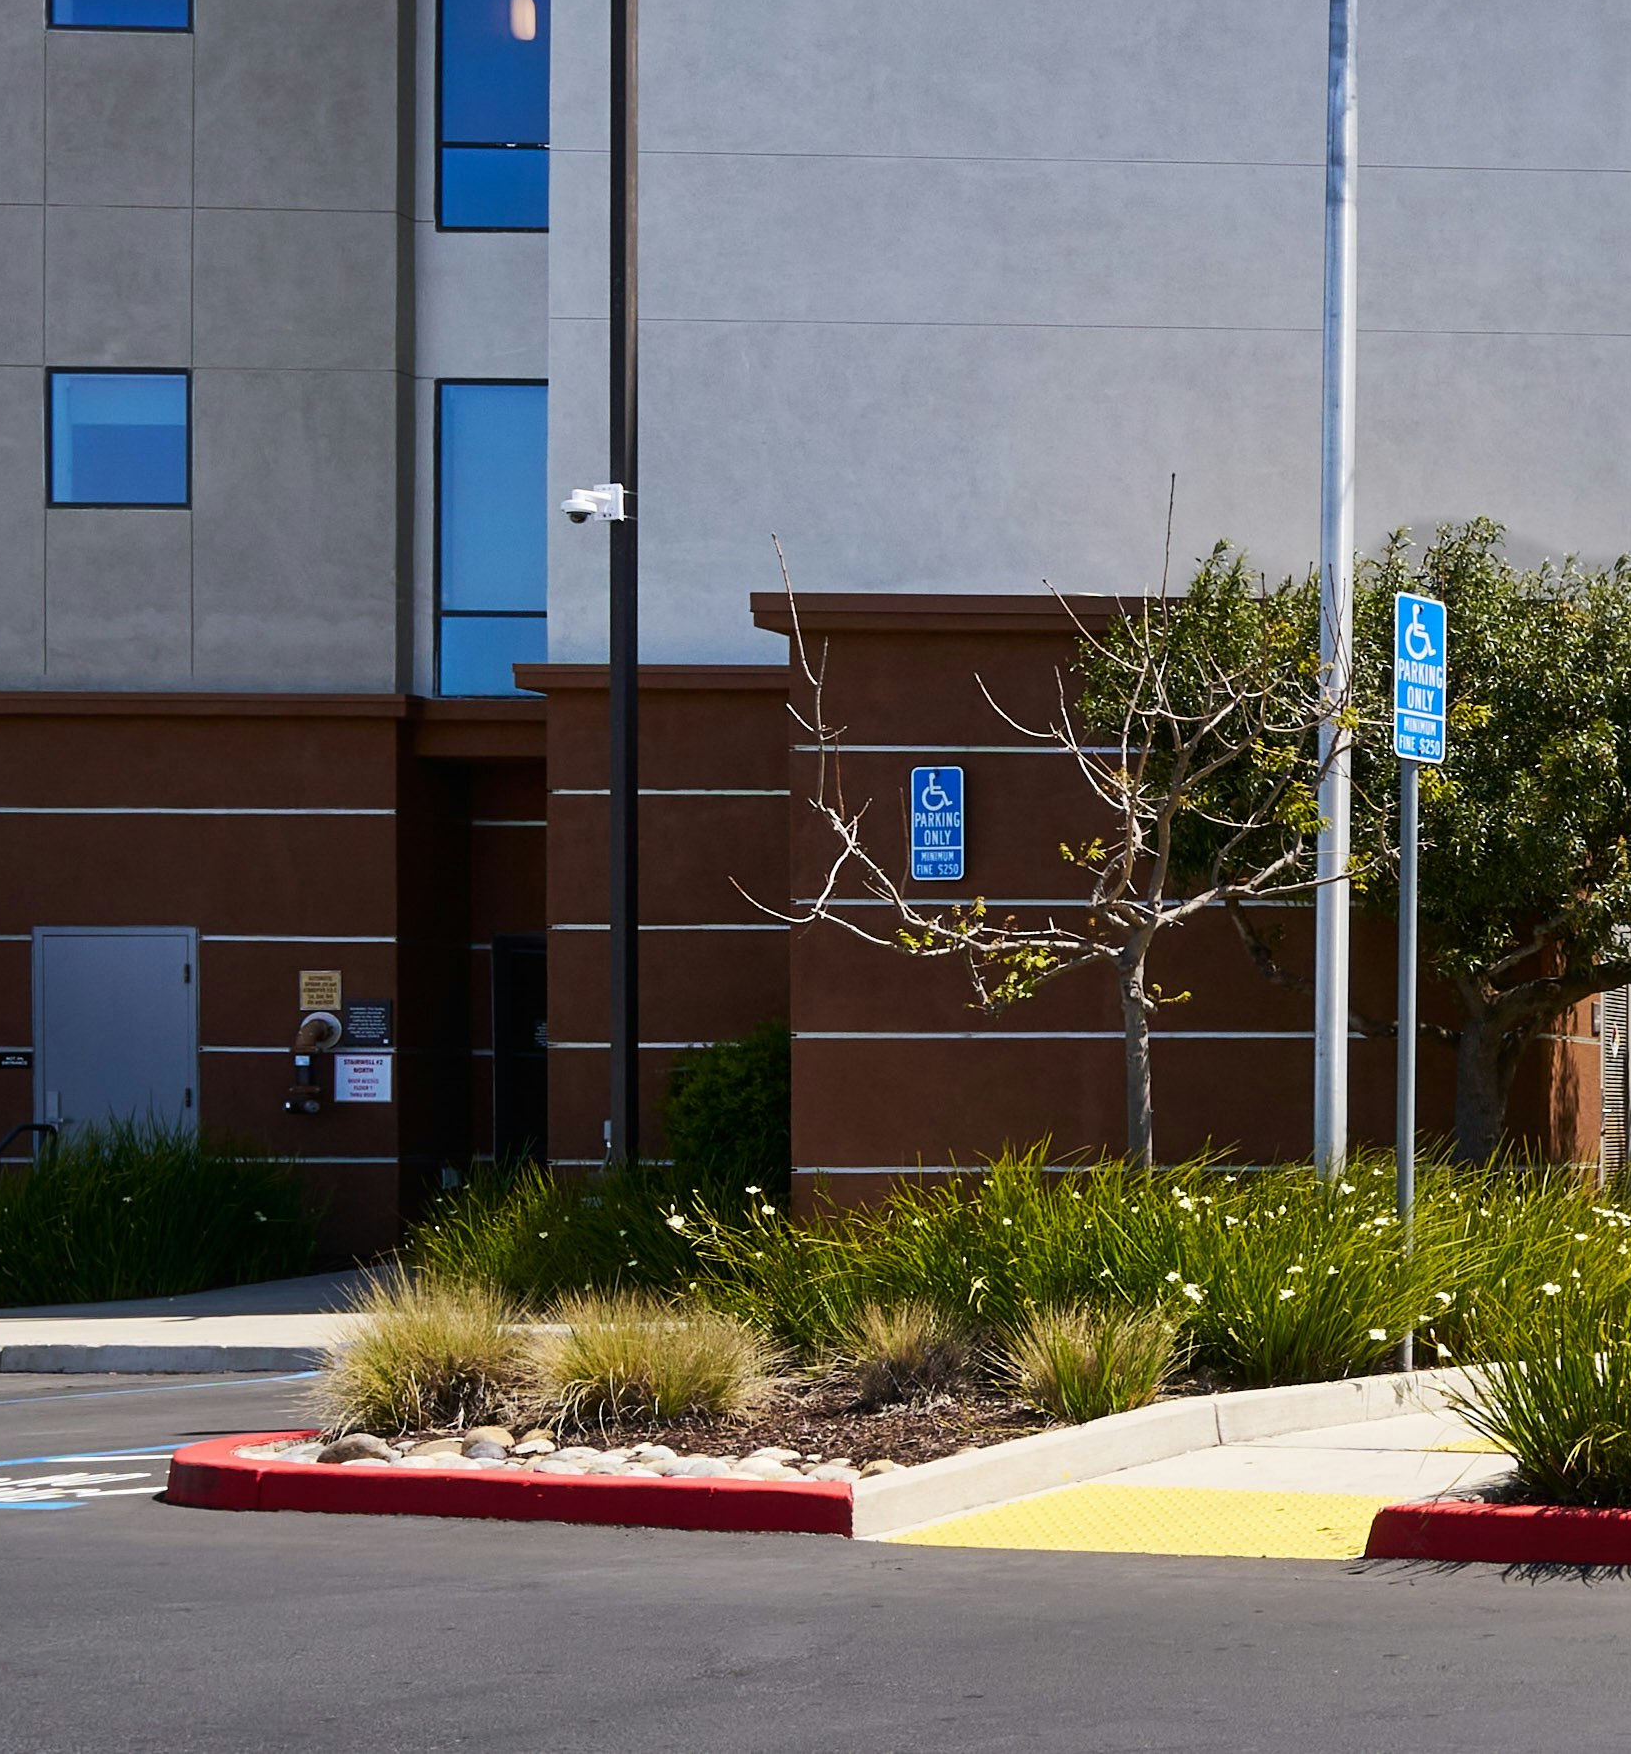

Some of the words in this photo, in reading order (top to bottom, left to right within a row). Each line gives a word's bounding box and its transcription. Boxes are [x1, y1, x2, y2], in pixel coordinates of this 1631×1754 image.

[1398, 658, 1443, 689] PARKING
[1406, 685, 1435, 712] ONLY
[1403, 716, 1436, 736] MINIMUM
[1399, 734, 1416, 752] FINE
[1419, 737, 1440, 756] $250
[914, 812, 960, 828] PARKING
[923, 830, 951, 845] ONLY
[921, 851, 954, 861] MINIMUM
[916, 864, 933, 875] FINE
[937, 863, 959, 875] $250
